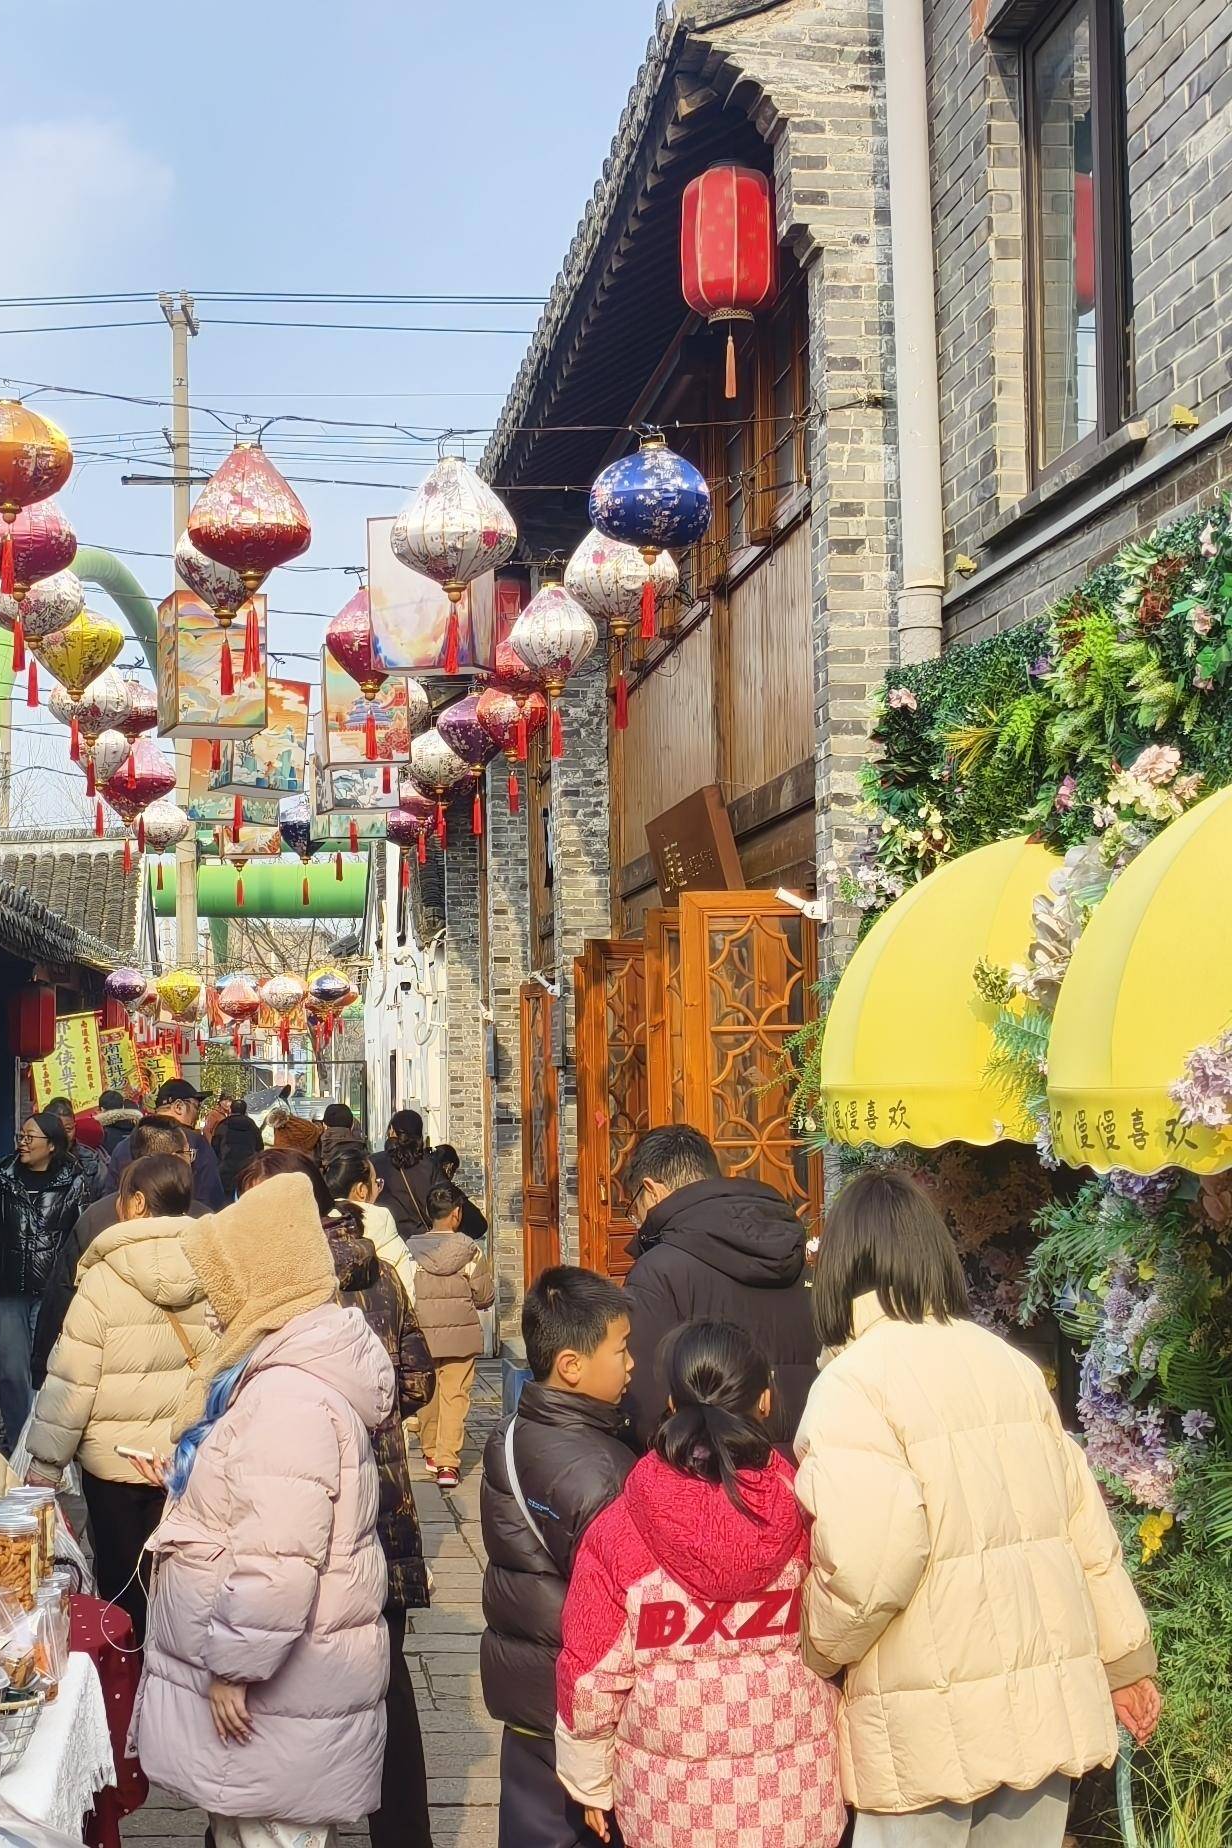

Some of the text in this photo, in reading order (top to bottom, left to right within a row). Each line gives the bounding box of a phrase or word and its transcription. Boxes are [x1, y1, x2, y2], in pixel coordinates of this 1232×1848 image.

[104, 1043, 127, 1088] 南昌拌粉
[832, 1099, 911, 1131] 慢慢喜欢
[1074, 1108, 1199, 1151] 慢慢喜欢
